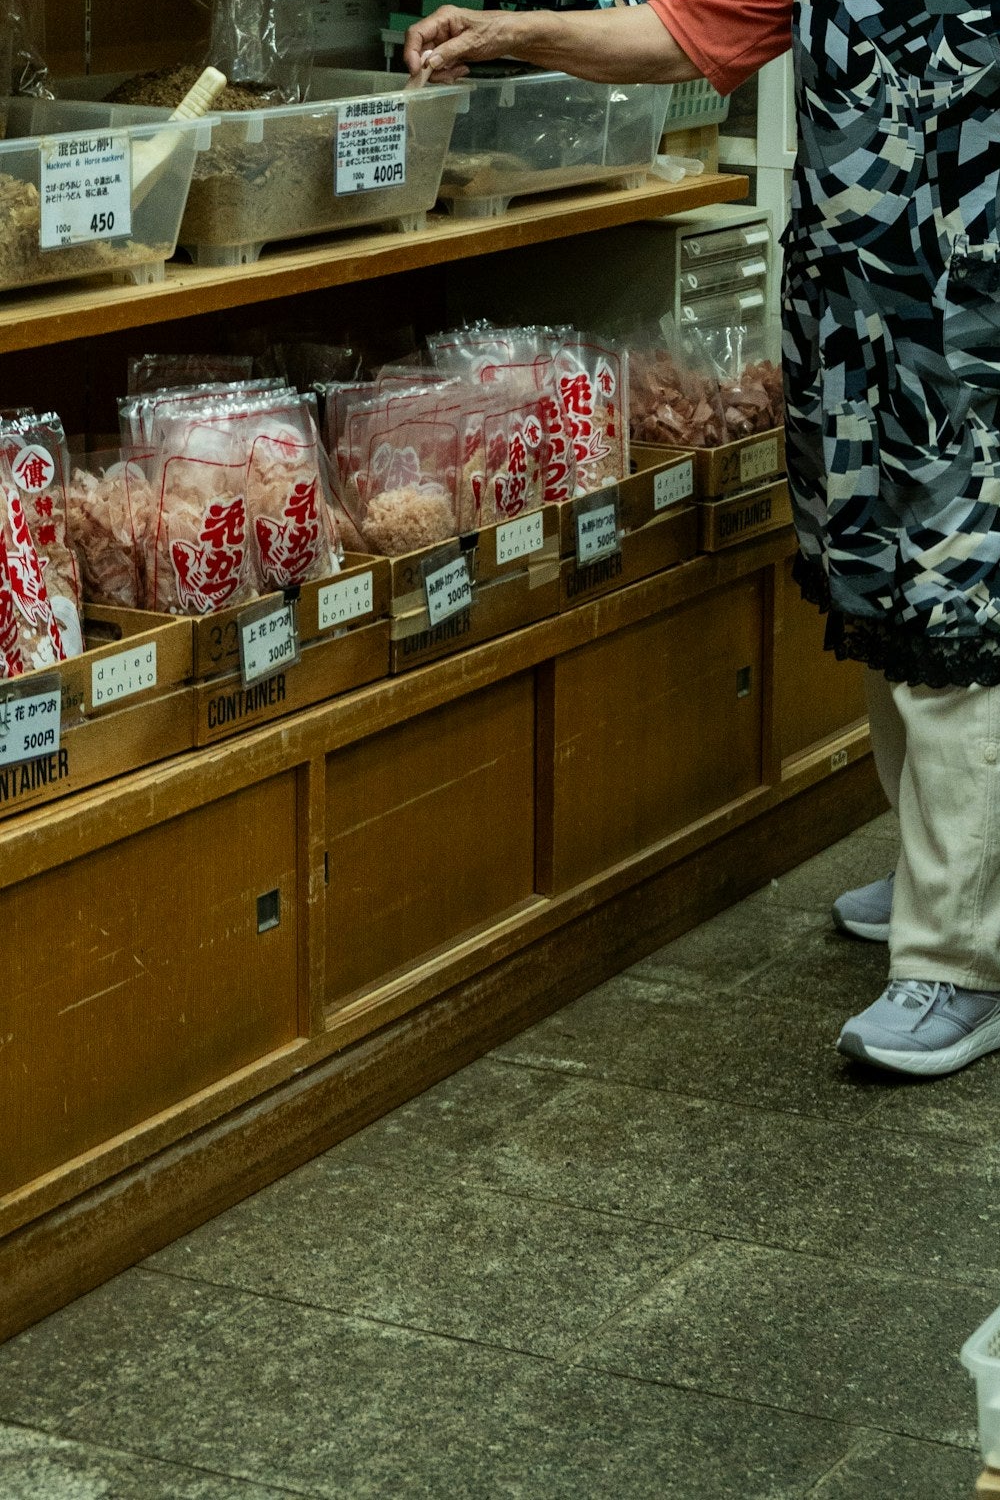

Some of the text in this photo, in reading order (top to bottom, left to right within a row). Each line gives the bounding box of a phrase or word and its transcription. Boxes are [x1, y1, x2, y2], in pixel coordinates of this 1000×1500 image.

[374, 162, 404, 183] 400円
[90, 211, 115, 233] 450
[499, 518, 542, 543] dried
[499, 536, 542, 560] bonito
[322, 579, 370, 606] dried
[321, 598, 371, 624] bonito
[268, 639, 293, 663] 300円
[96, 651, 152, 681] dried
[96, 672, 154, 701] bonito
[207, 673, 287, 730] CONTAINER
[23, 729, 55, 751] 500円
